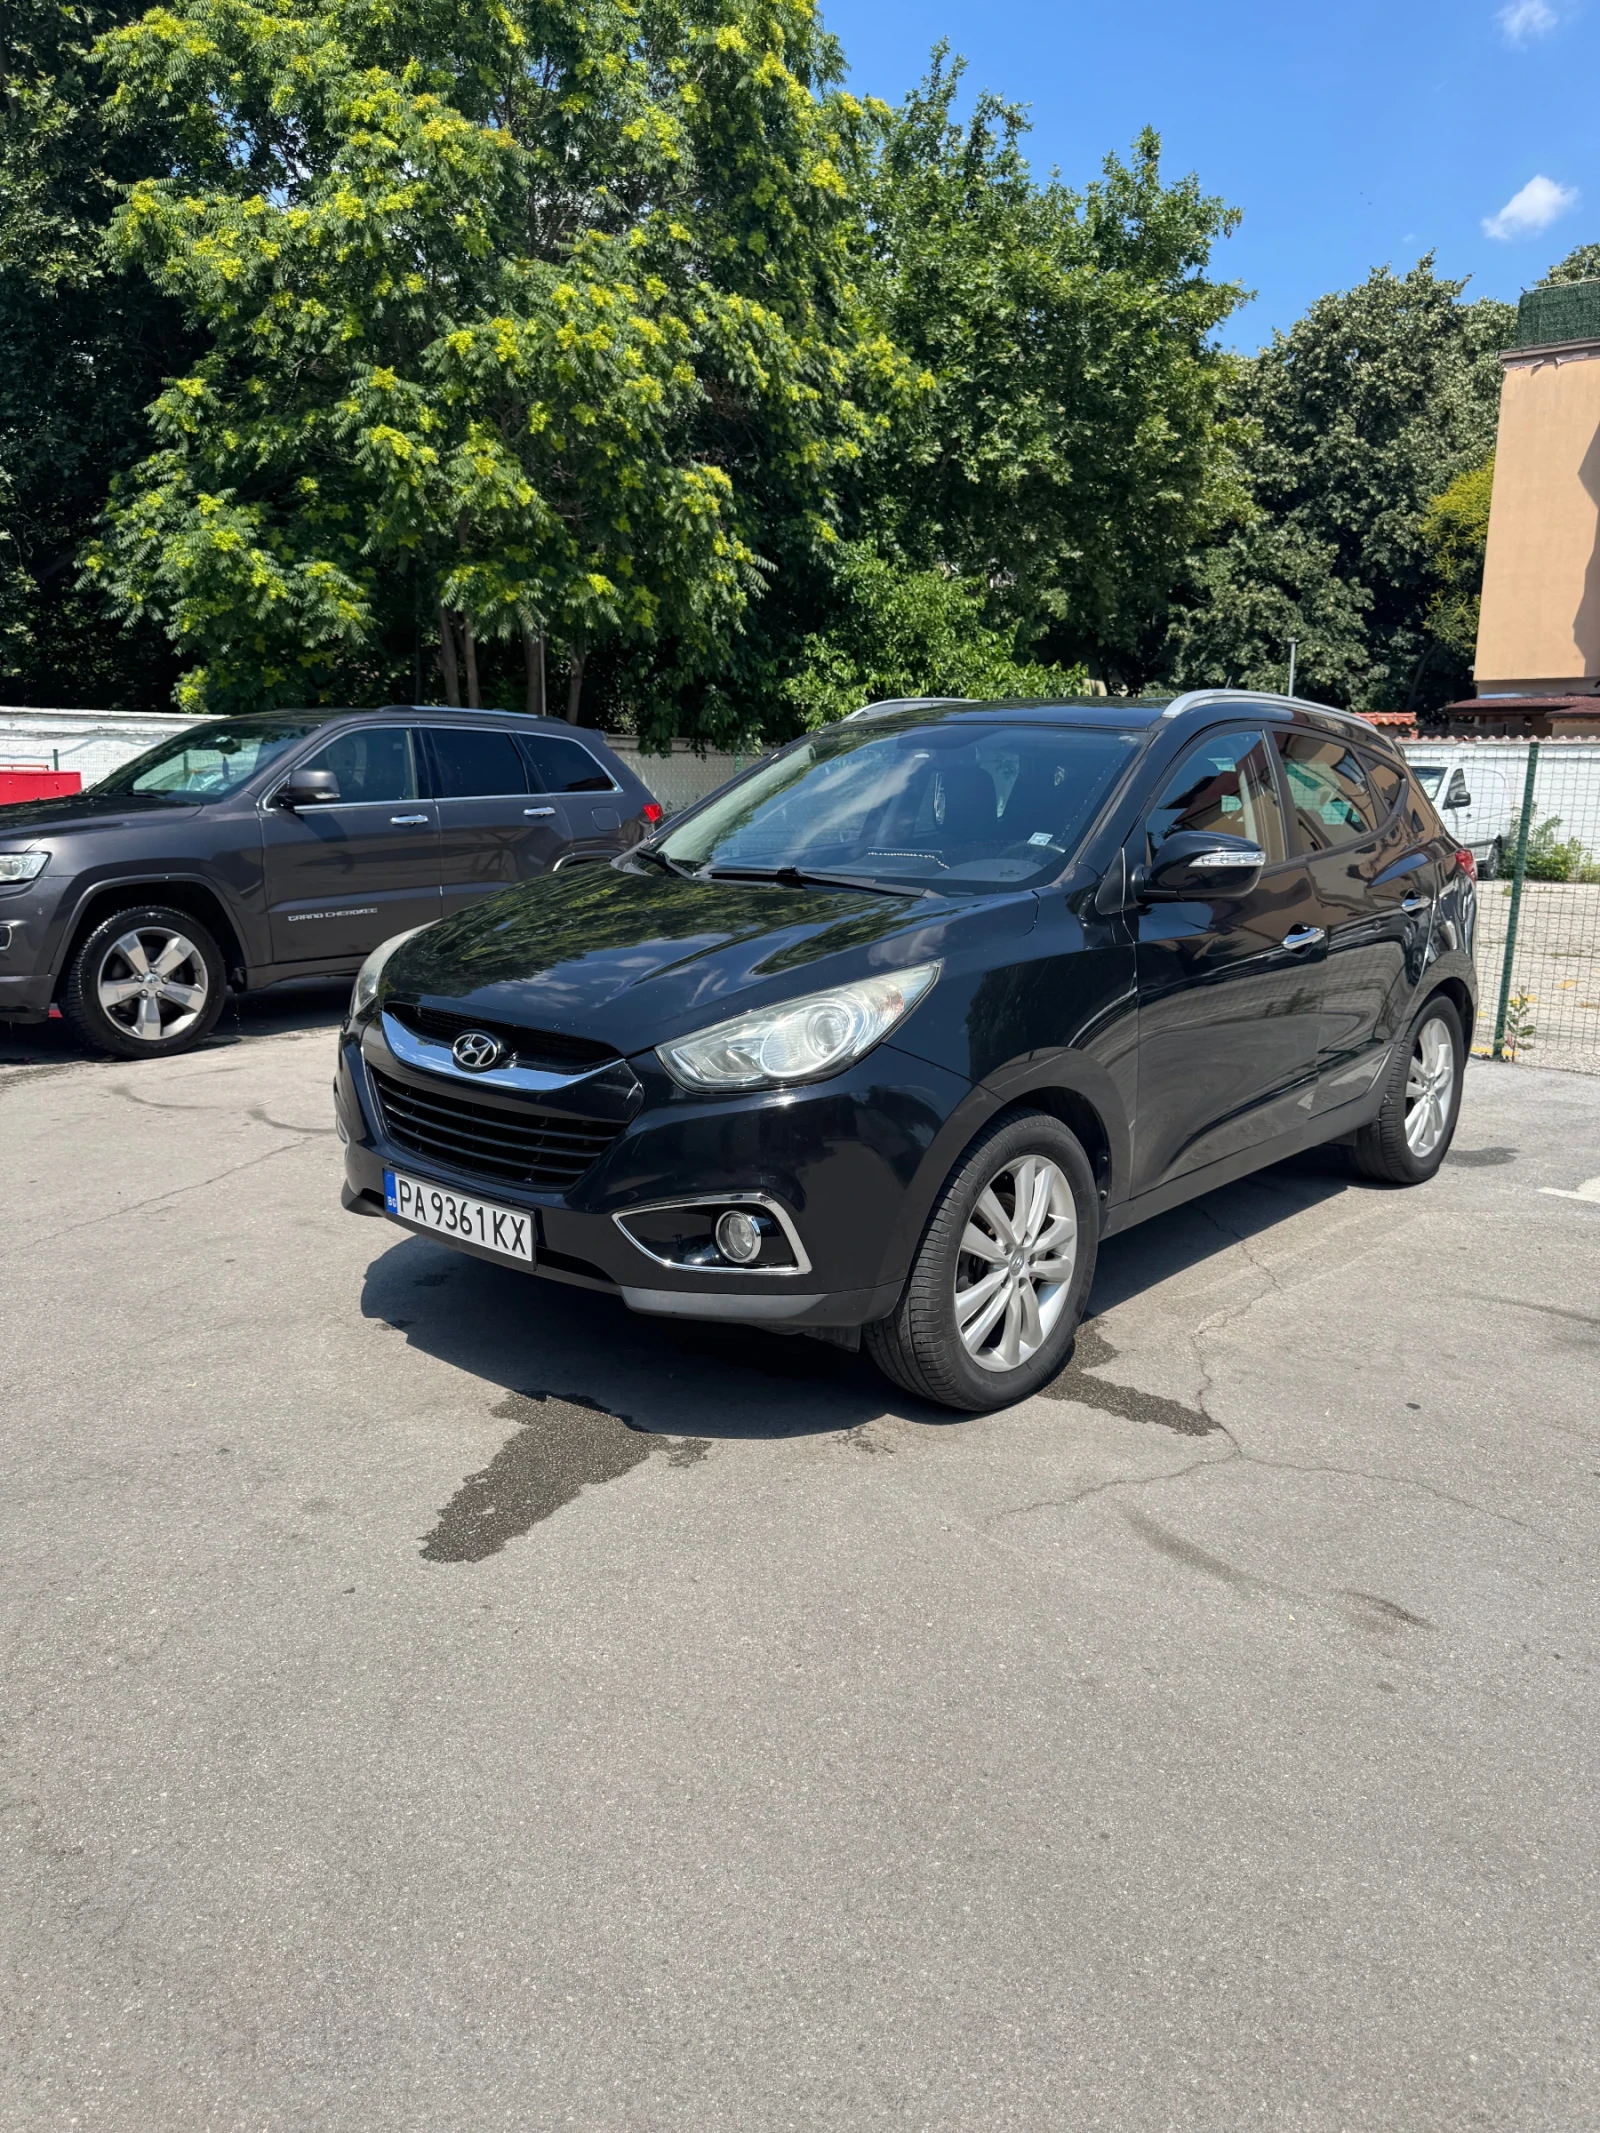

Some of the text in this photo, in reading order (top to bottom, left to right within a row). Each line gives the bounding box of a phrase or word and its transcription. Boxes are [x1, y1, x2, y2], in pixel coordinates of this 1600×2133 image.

[287, 907, 378, 922] GRAND CHEROKEE
[387, 1195, 397, 1208] BG
